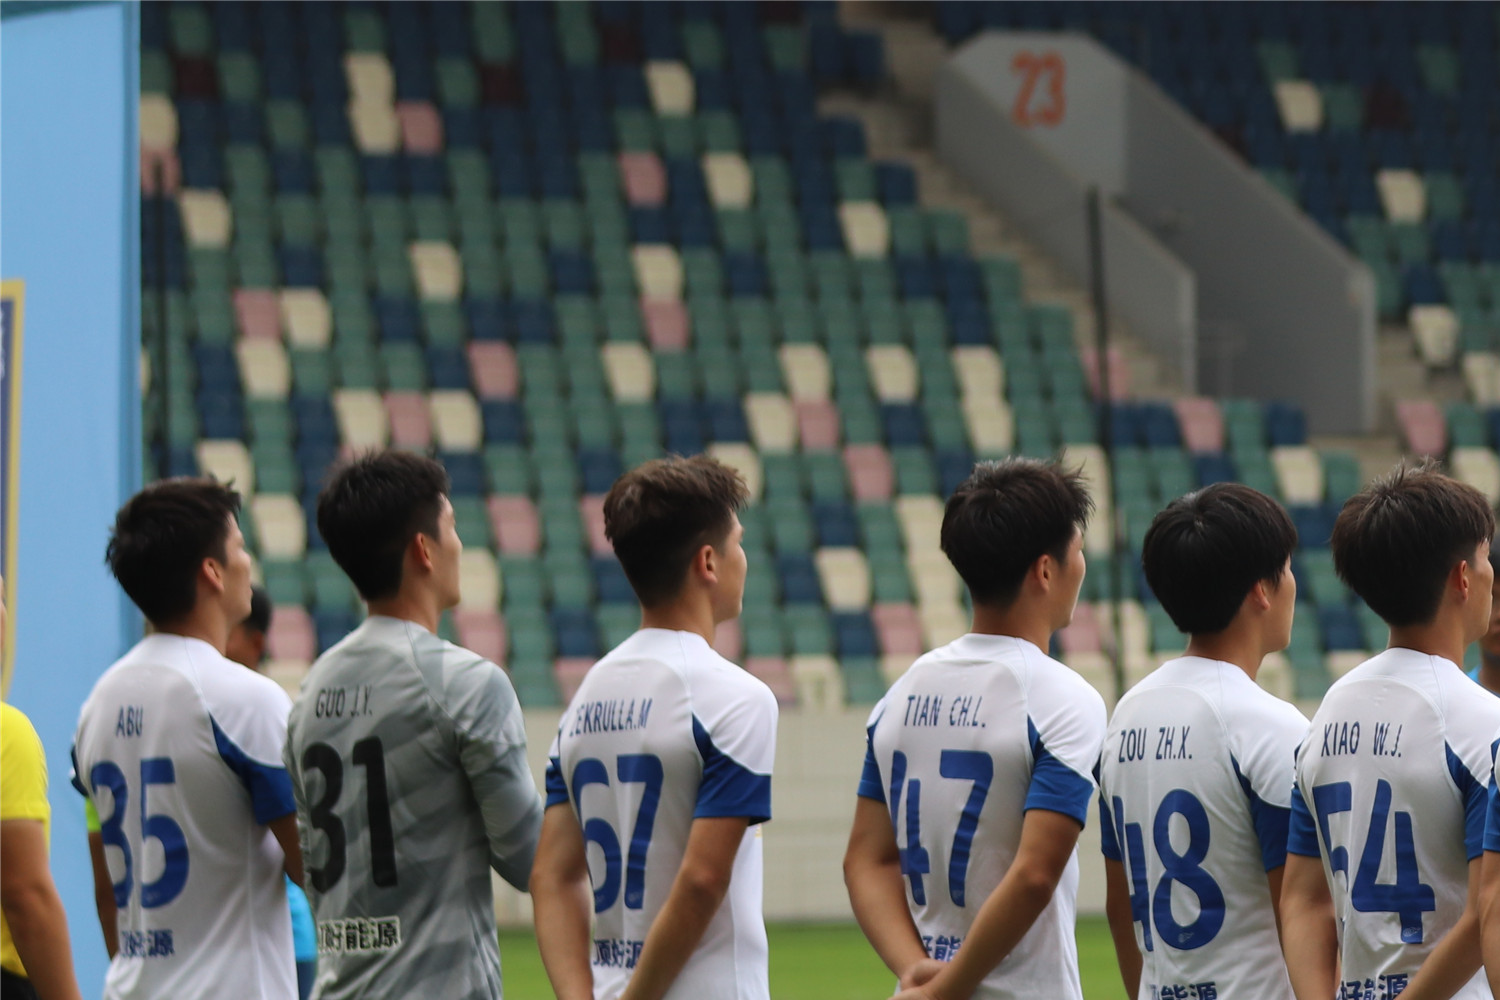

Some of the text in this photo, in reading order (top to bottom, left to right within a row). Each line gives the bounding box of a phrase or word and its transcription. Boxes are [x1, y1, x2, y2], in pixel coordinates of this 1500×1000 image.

[1010, 51, 1066, 127] 23
[116, 706, 143, 738] ABU
[315, 687, 345, 718] GUO
[904, 695, 941, 727] TIAN
[1321, 721, 1360, 758] XIAO
[1119, 728, 1147, 763] ZOU
[91, 757, 190, 909] 35
[303, 736, 398, 894] 31
[572, 754, 664, 914] 67
[890, 749, 993, 908] 47
[1312, 778, 1436, 944] 54
